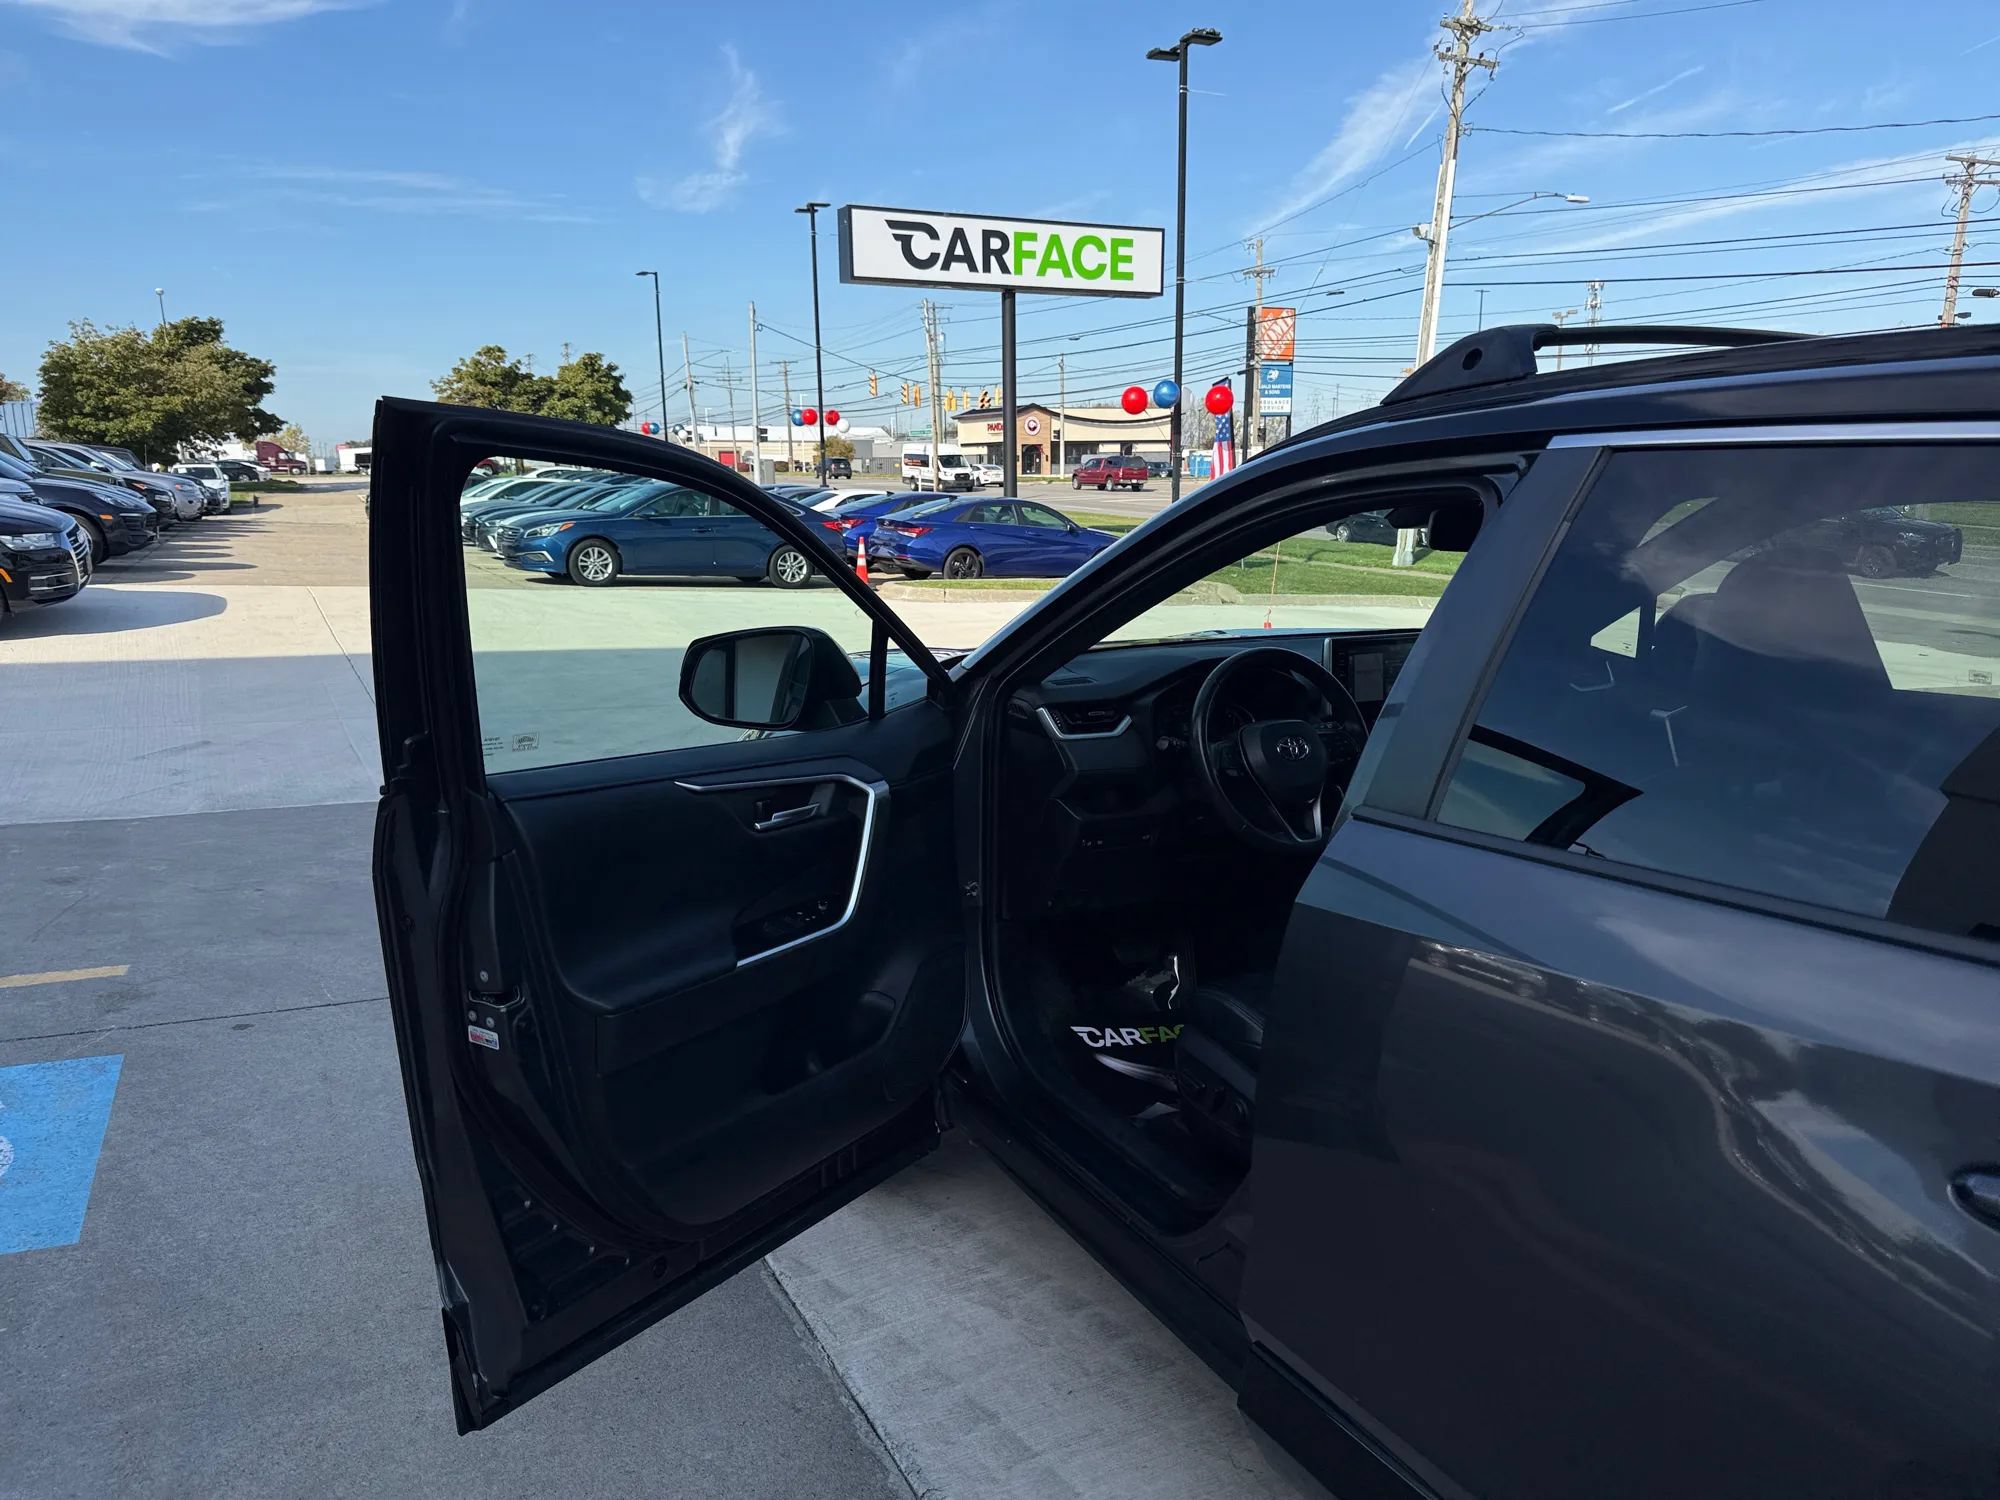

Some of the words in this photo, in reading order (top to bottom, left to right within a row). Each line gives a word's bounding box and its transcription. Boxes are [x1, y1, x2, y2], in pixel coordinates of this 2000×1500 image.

[885, 219, 1134, 281] CARFACE
[987, 423, 1003, 432] PAND
[1070, 1024, 1185, 1048] CARFA
